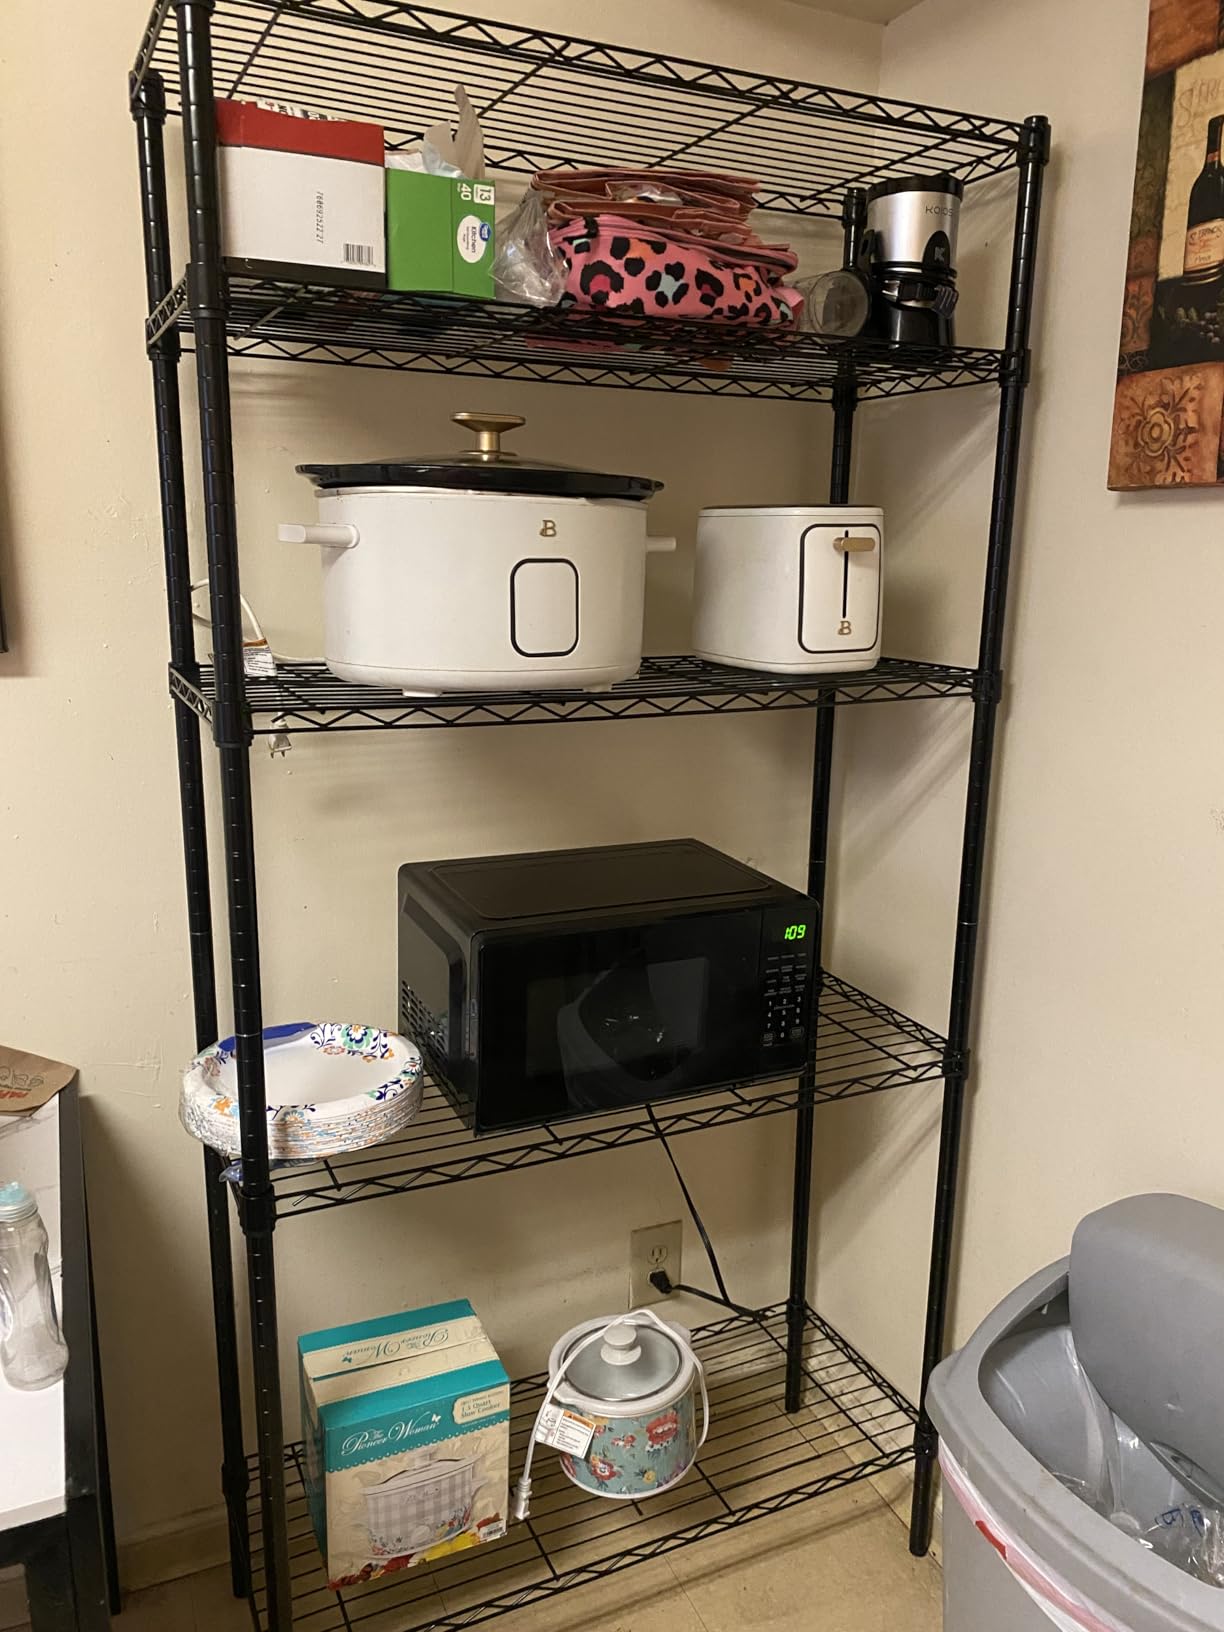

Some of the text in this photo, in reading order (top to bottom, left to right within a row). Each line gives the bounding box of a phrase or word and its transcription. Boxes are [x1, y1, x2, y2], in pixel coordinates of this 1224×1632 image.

[460, 183, 472, 201] 40
[480, 188, 491, 201] 13
[540, 519, 557, 538] B
[838, 620, 852, 636] B
[784, 925, 806, 940] 1:09
[341, 1431, 389, 1456] Pioneer
[388, 1411, 437, 1441] Woman
